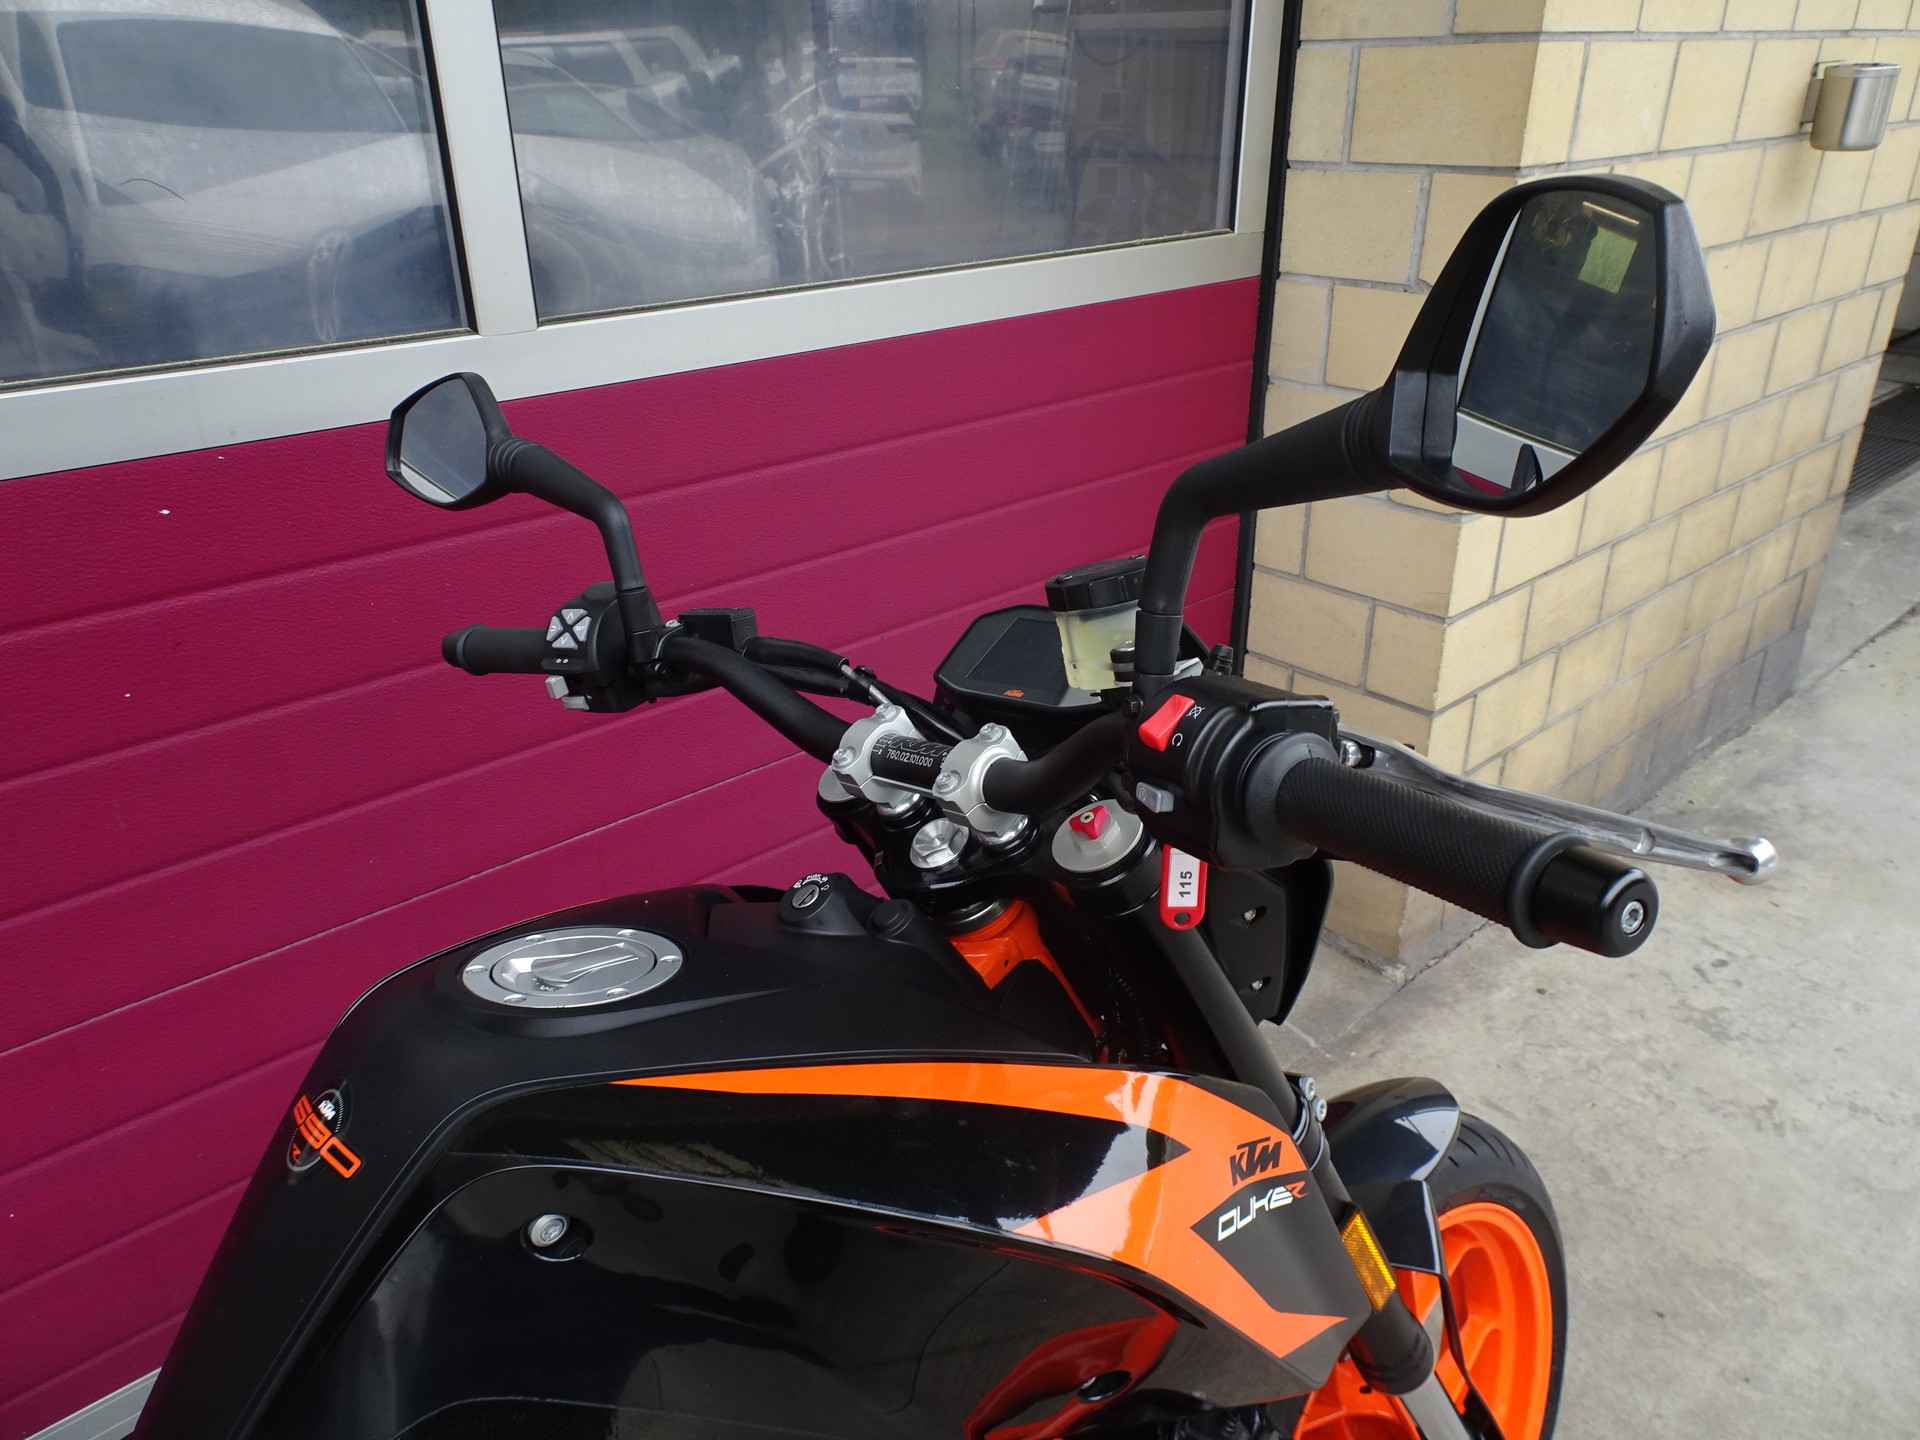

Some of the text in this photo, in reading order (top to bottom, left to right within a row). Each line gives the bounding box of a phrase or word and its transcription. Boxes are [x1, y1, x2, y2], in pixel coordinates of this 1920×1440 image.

[1003, 689, 1025, 698] KTM
[1178, 870, 1193, 898] 115
[317, 1099, 337, 1121] KTM
[292, 1094, 363, 1179] 690
[1229, 1136, 1282, 1187] KTM
